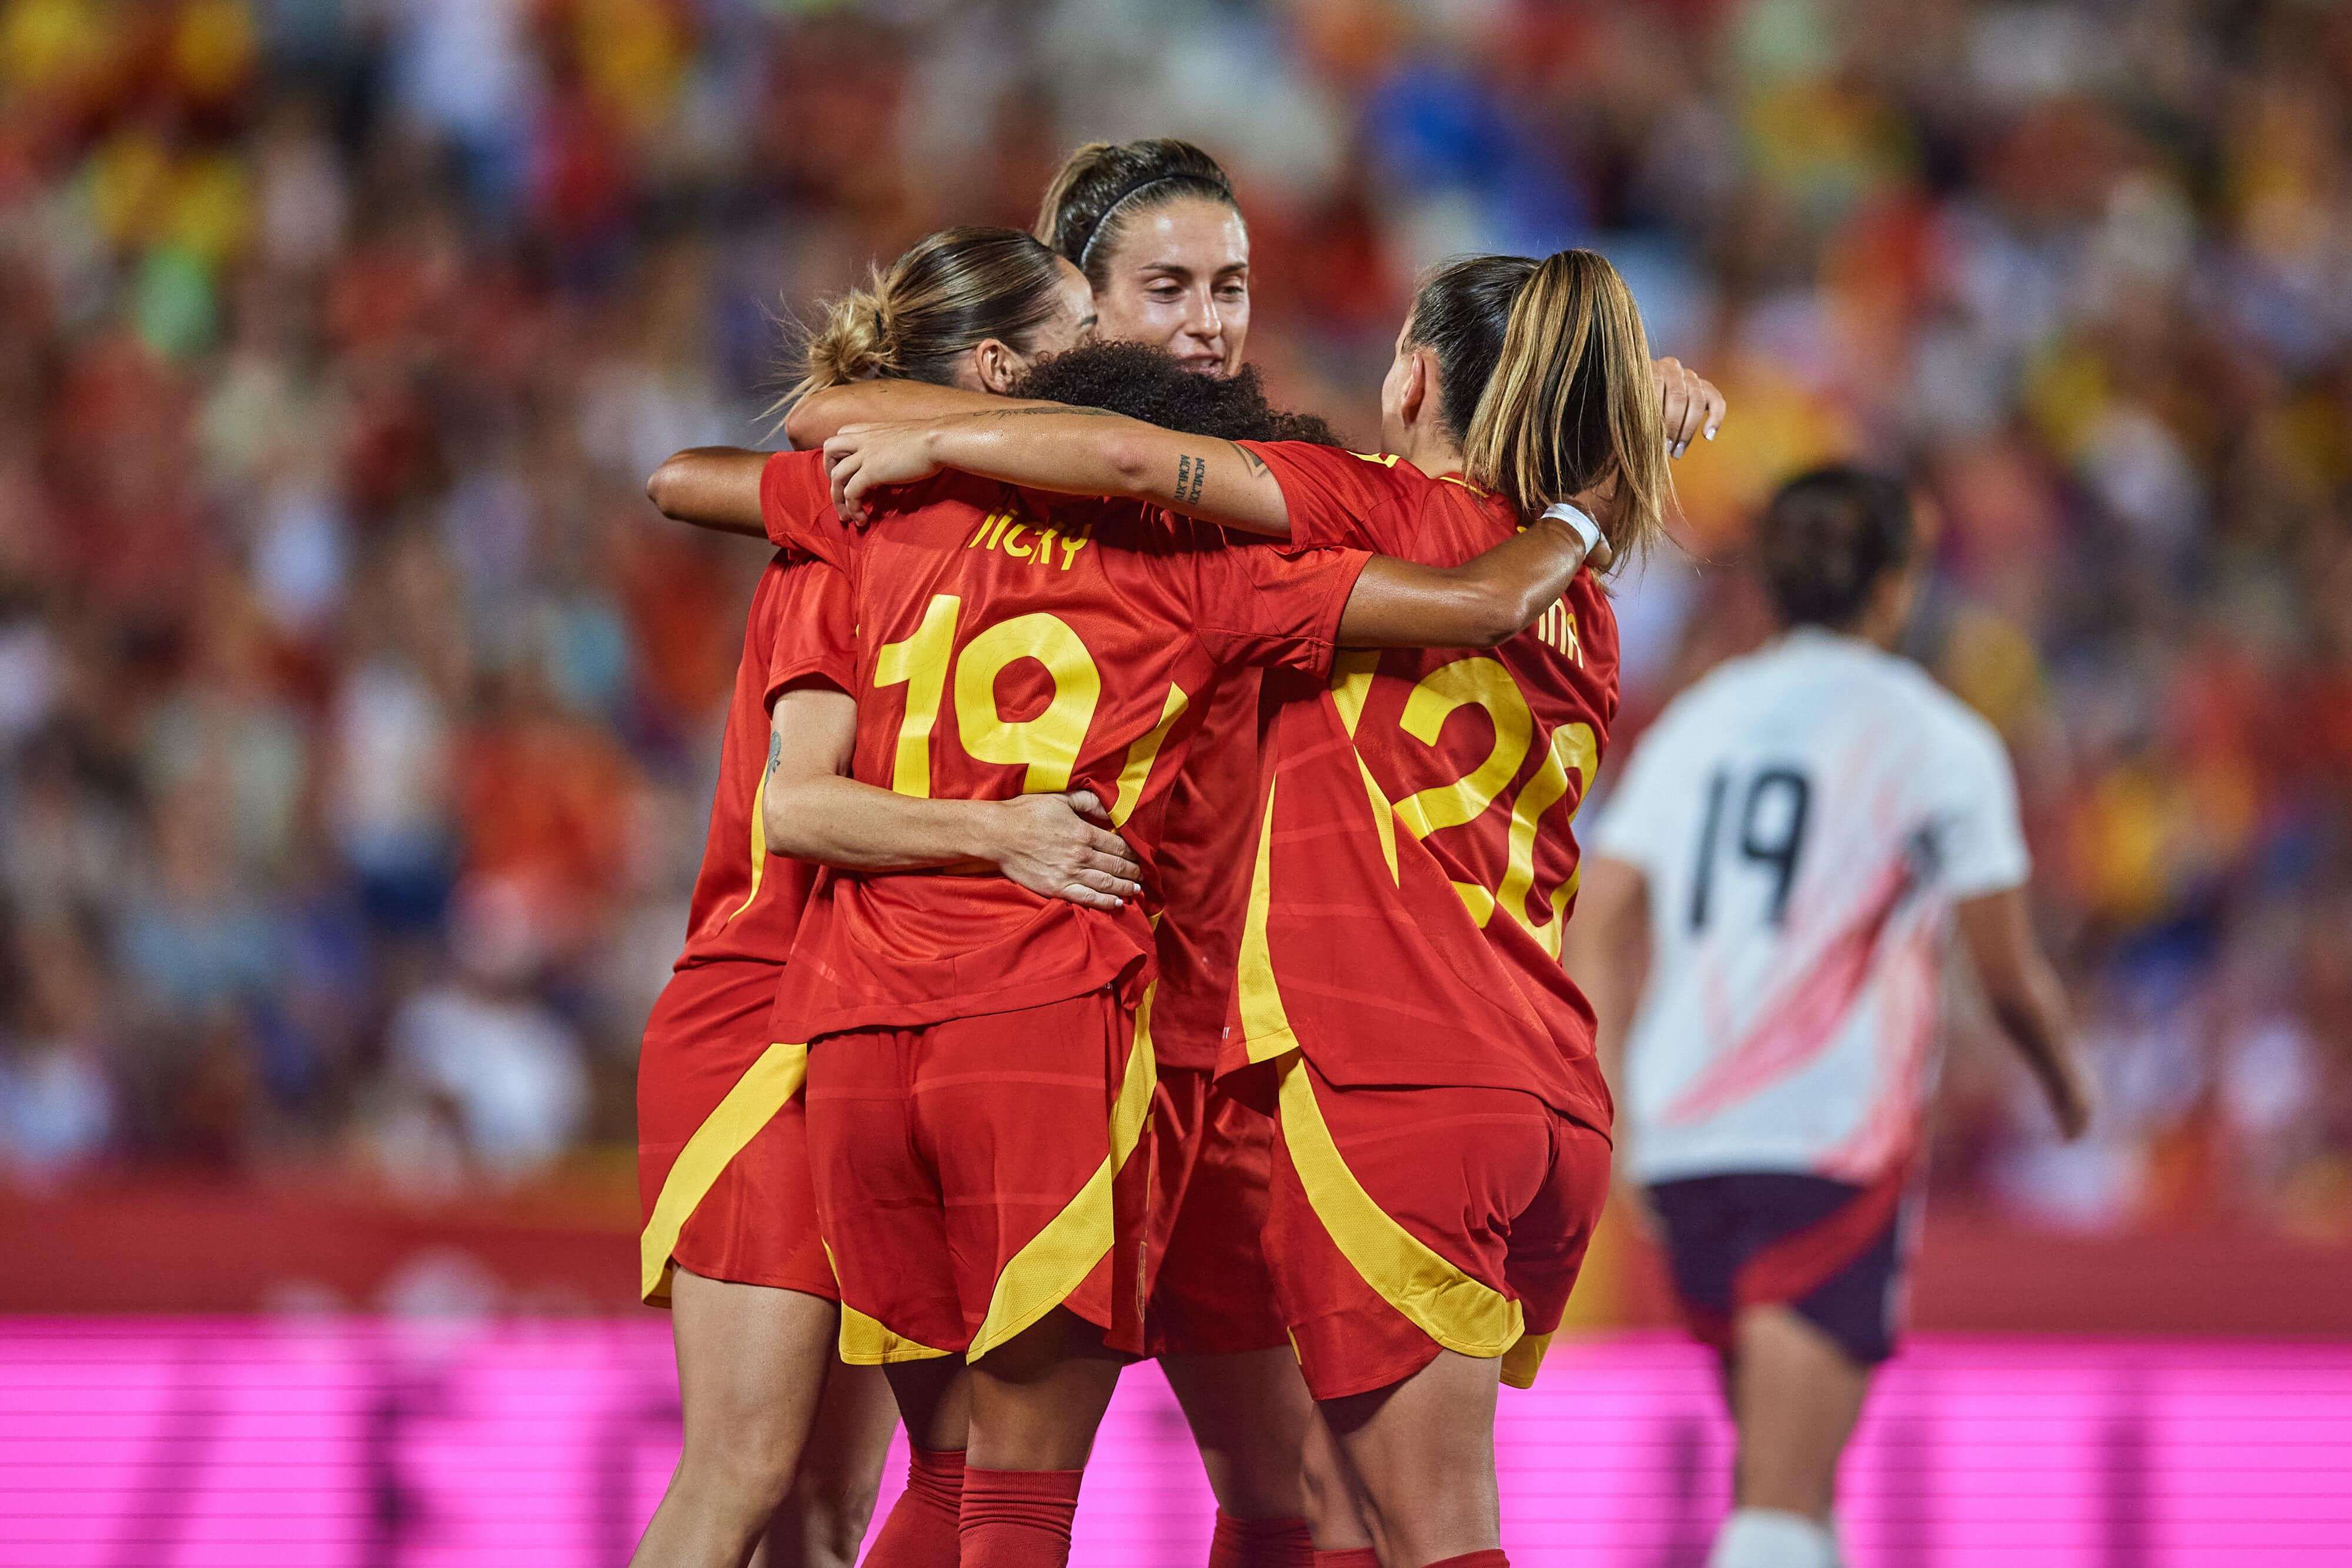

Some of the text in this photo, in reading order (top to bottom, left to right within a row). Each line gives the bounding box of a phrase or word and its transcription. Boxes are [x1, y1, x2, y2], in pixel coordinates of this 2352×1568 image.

[873, 594, 1101, 800] 19
[1538, 597, 1583, 669] INA
[1392, 657, 1598, 961] 20
[1686, 763, 1813, 930] 19
